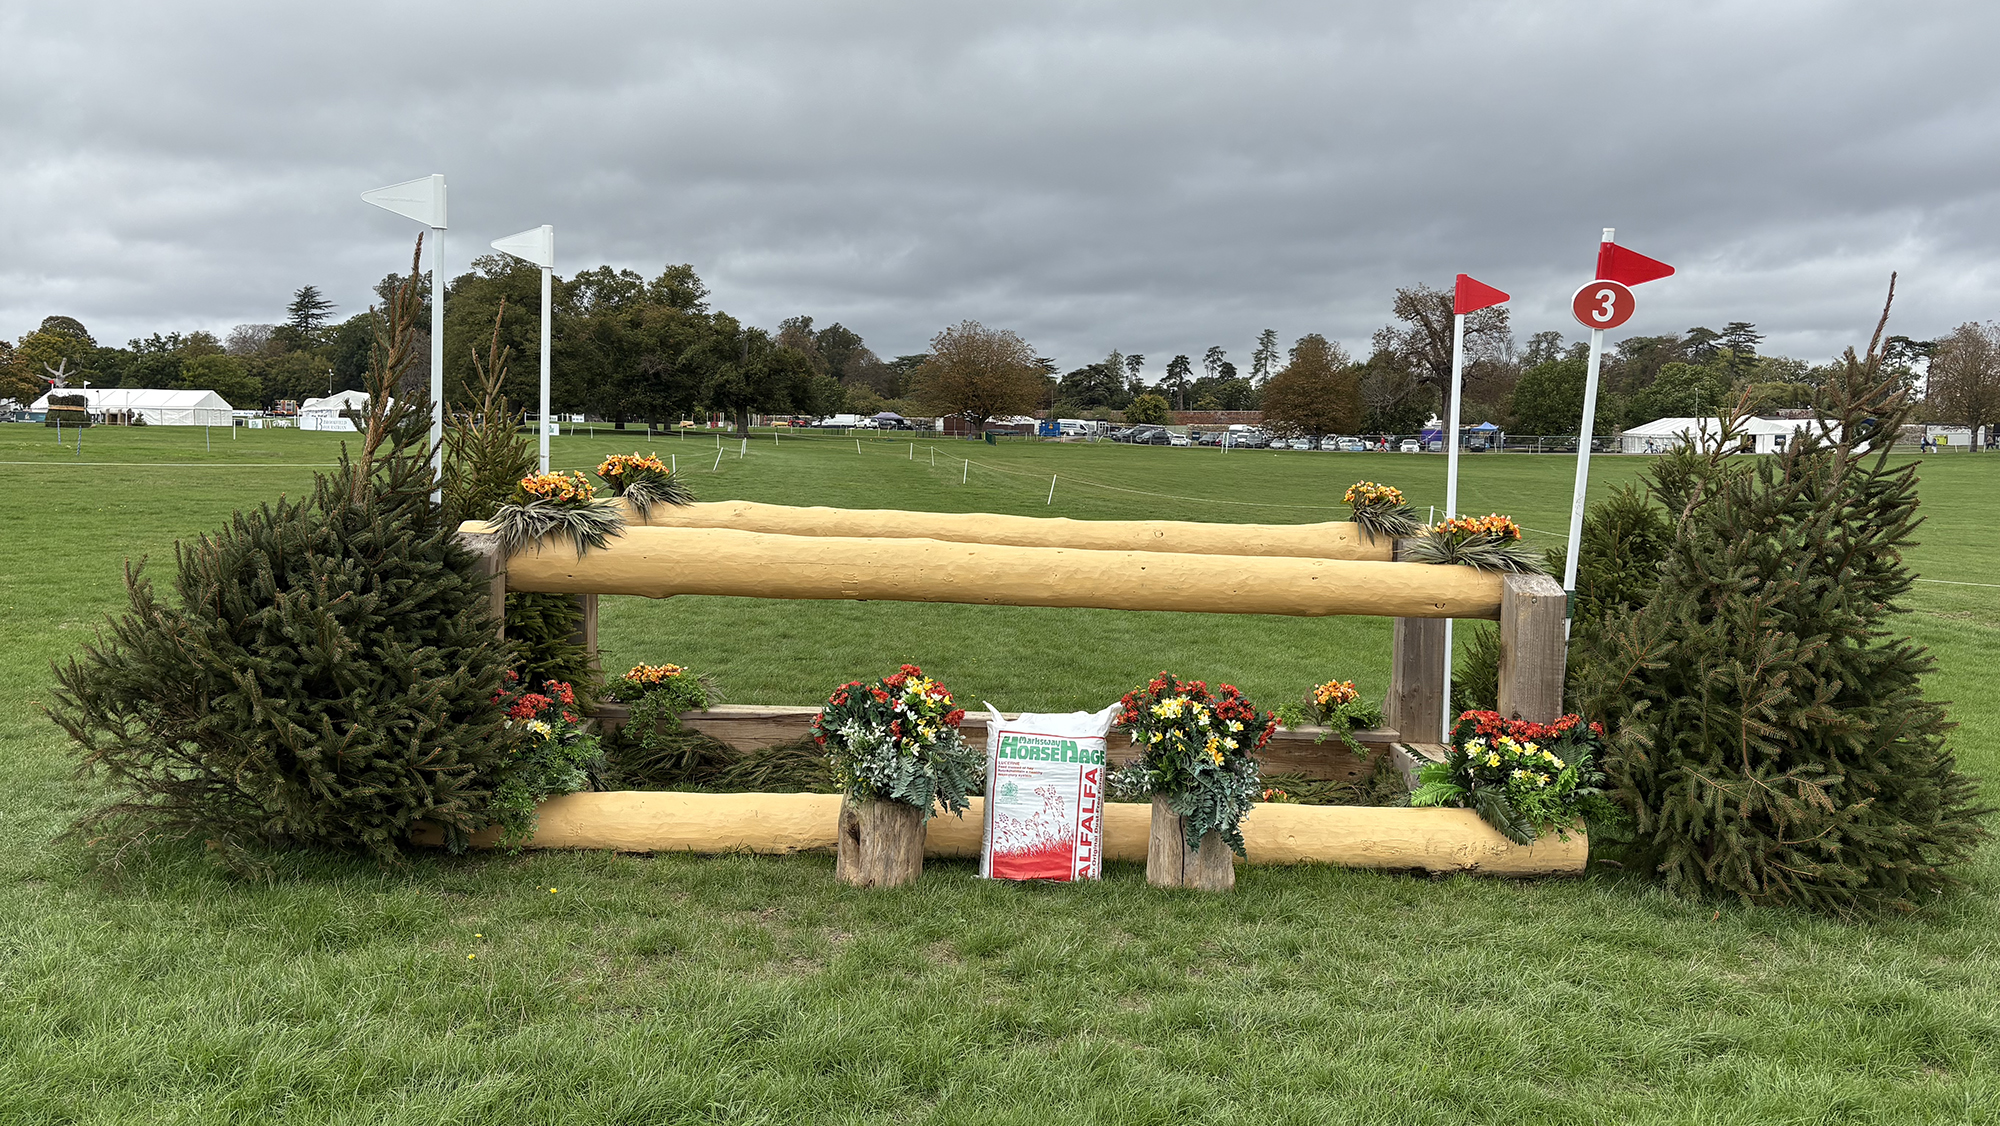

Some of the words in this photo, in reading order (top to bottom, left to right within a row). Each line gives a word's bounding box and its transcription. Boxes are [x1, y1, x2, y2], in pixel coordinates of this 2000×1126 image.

[1592, 288, 1616, 322] 3
[1019, 736, 1061, 748] Marksway
[1079, 768, 1098, 880] ALFALFA
